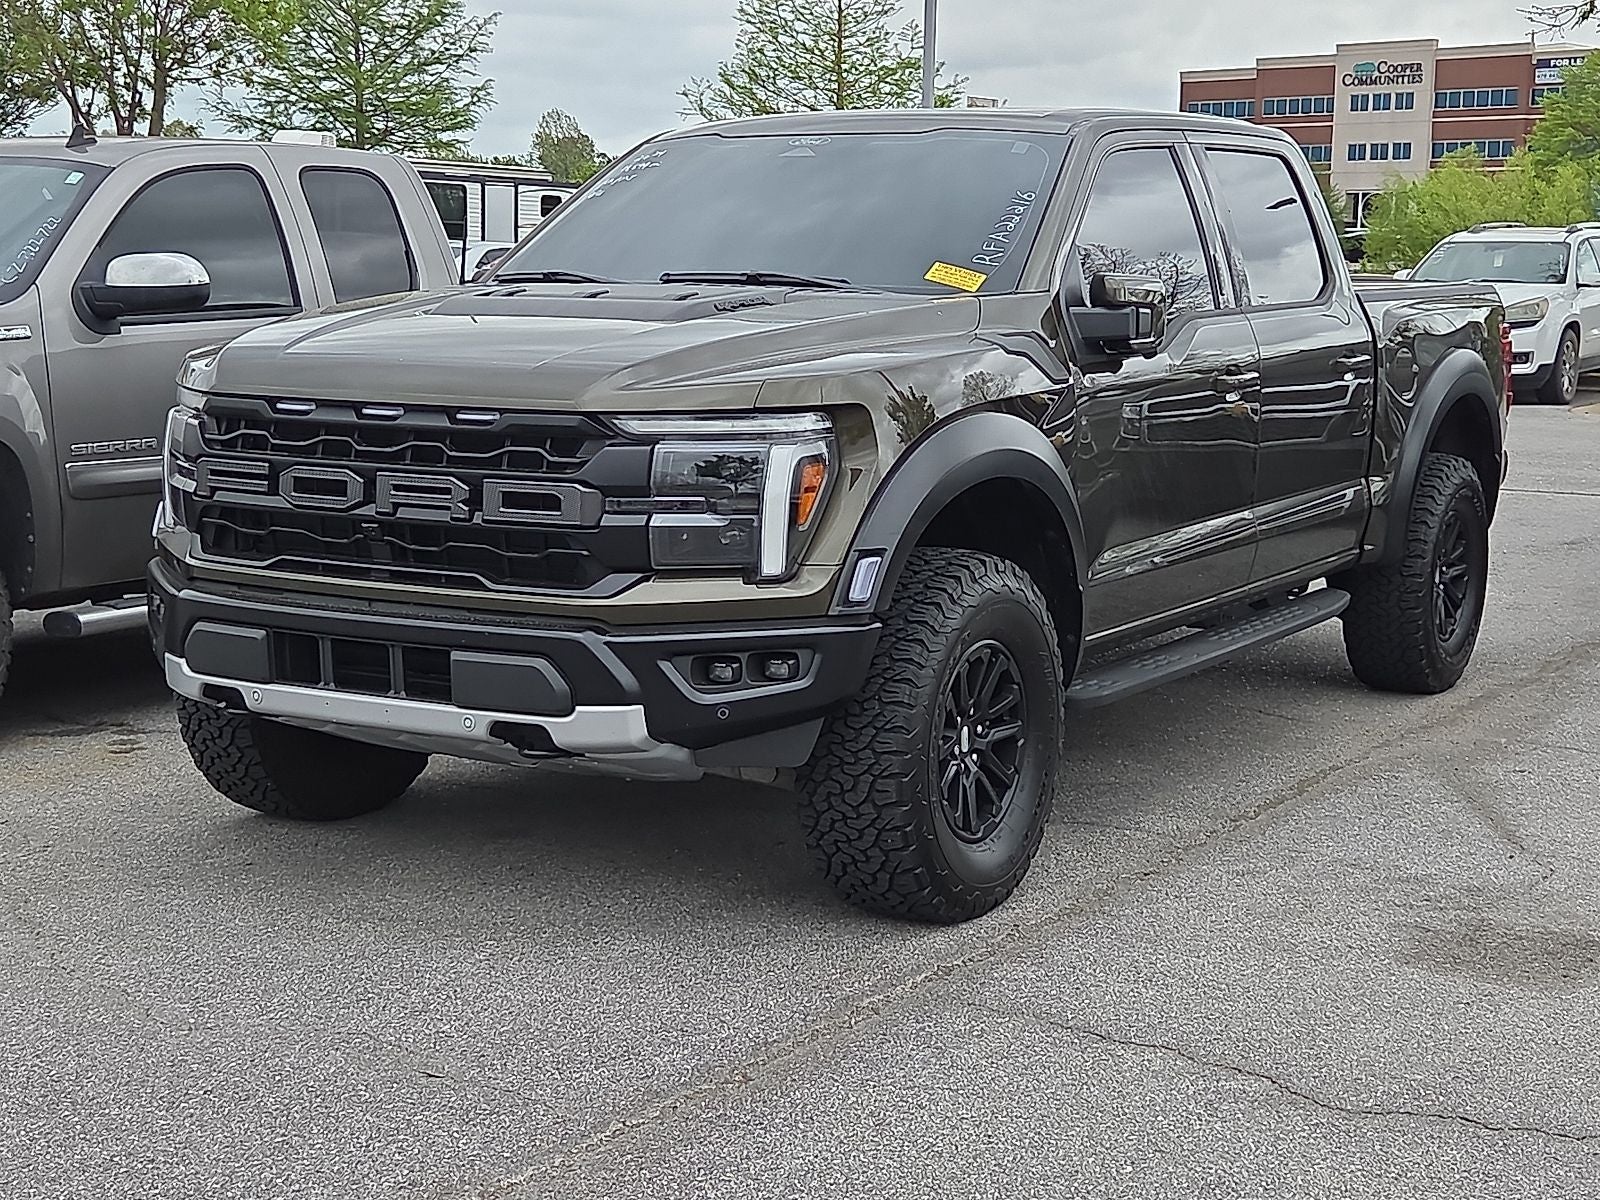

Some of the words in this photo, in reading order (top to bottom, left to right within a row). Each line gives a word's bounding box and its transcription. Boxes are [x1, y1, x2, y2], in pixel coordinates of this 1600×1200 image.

[1377, 60, 1423, 75] COOPER
[1550, 59, 1570, 67] FOR
[1571, 57, 1586, 66] LE
[1342, 73, 1424, 87] COMMUNITIES
[971, 190, 1036, 266] RFA22216
[70, 438, 157, 456] SIERRA
[194, 457, 600, 527] FORD
